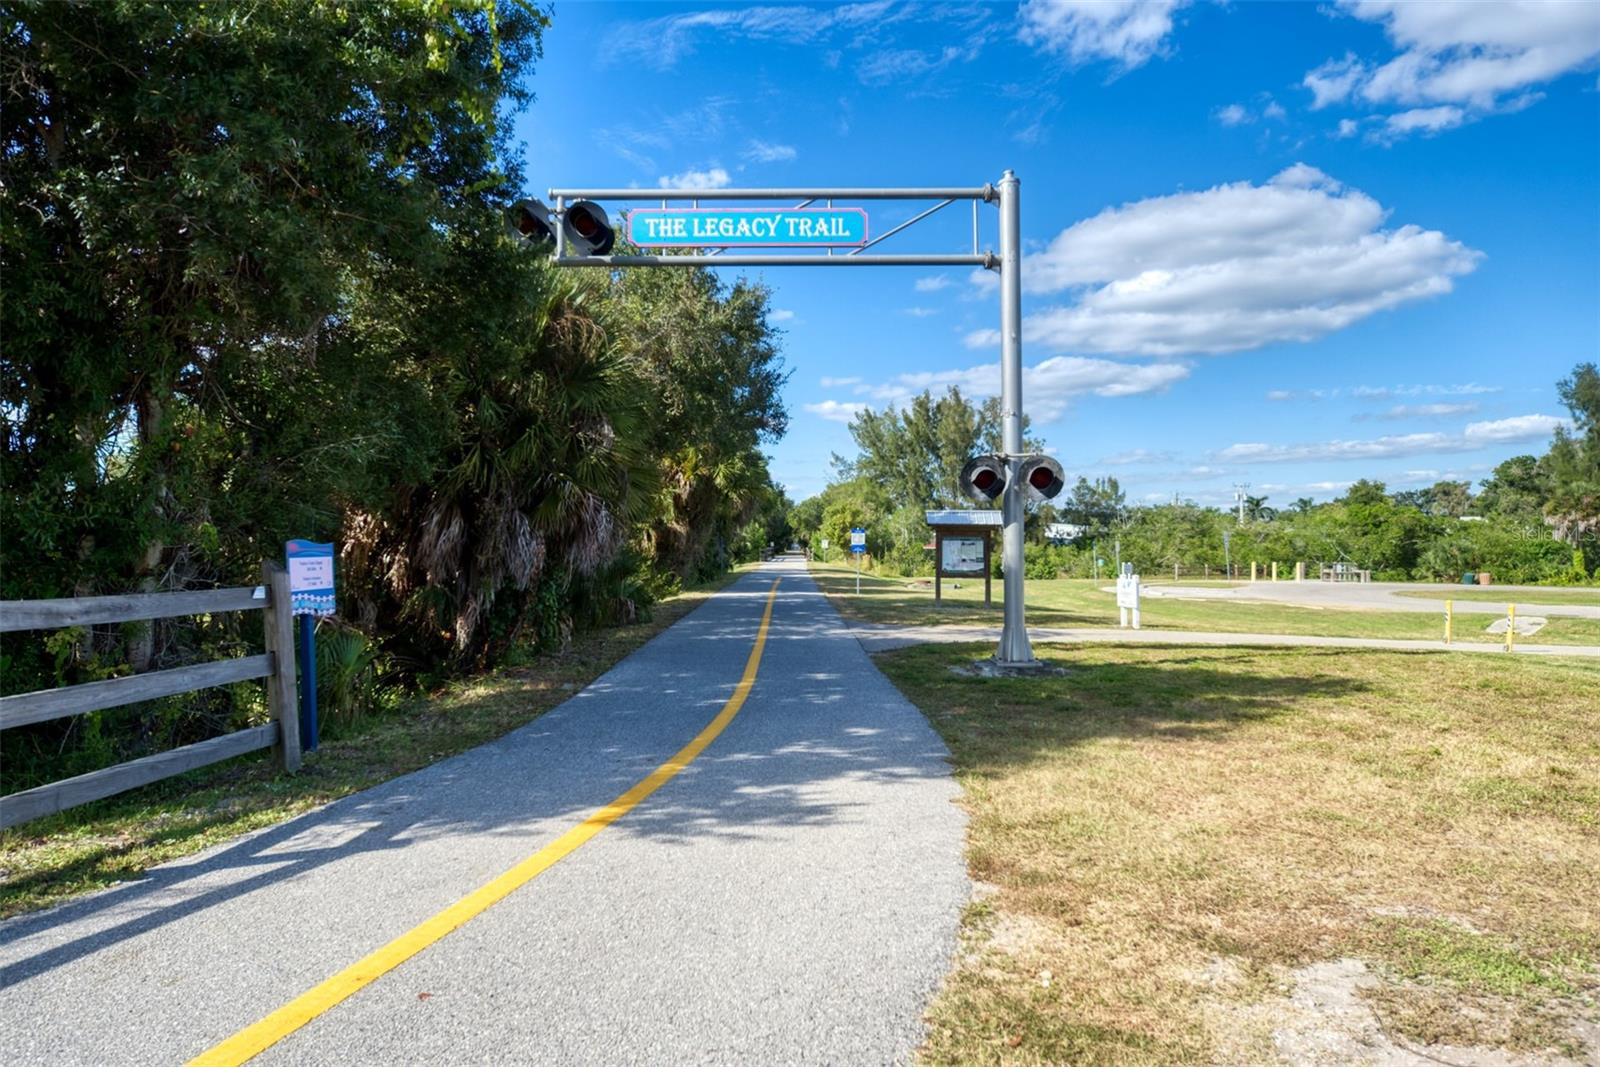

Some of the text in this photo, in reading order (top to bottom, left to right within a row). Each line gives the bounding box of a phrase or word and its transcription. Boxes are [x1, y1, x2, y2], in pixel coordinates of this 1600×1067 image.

[645, 214, 850, 238] THE LEGACY TRAIL
